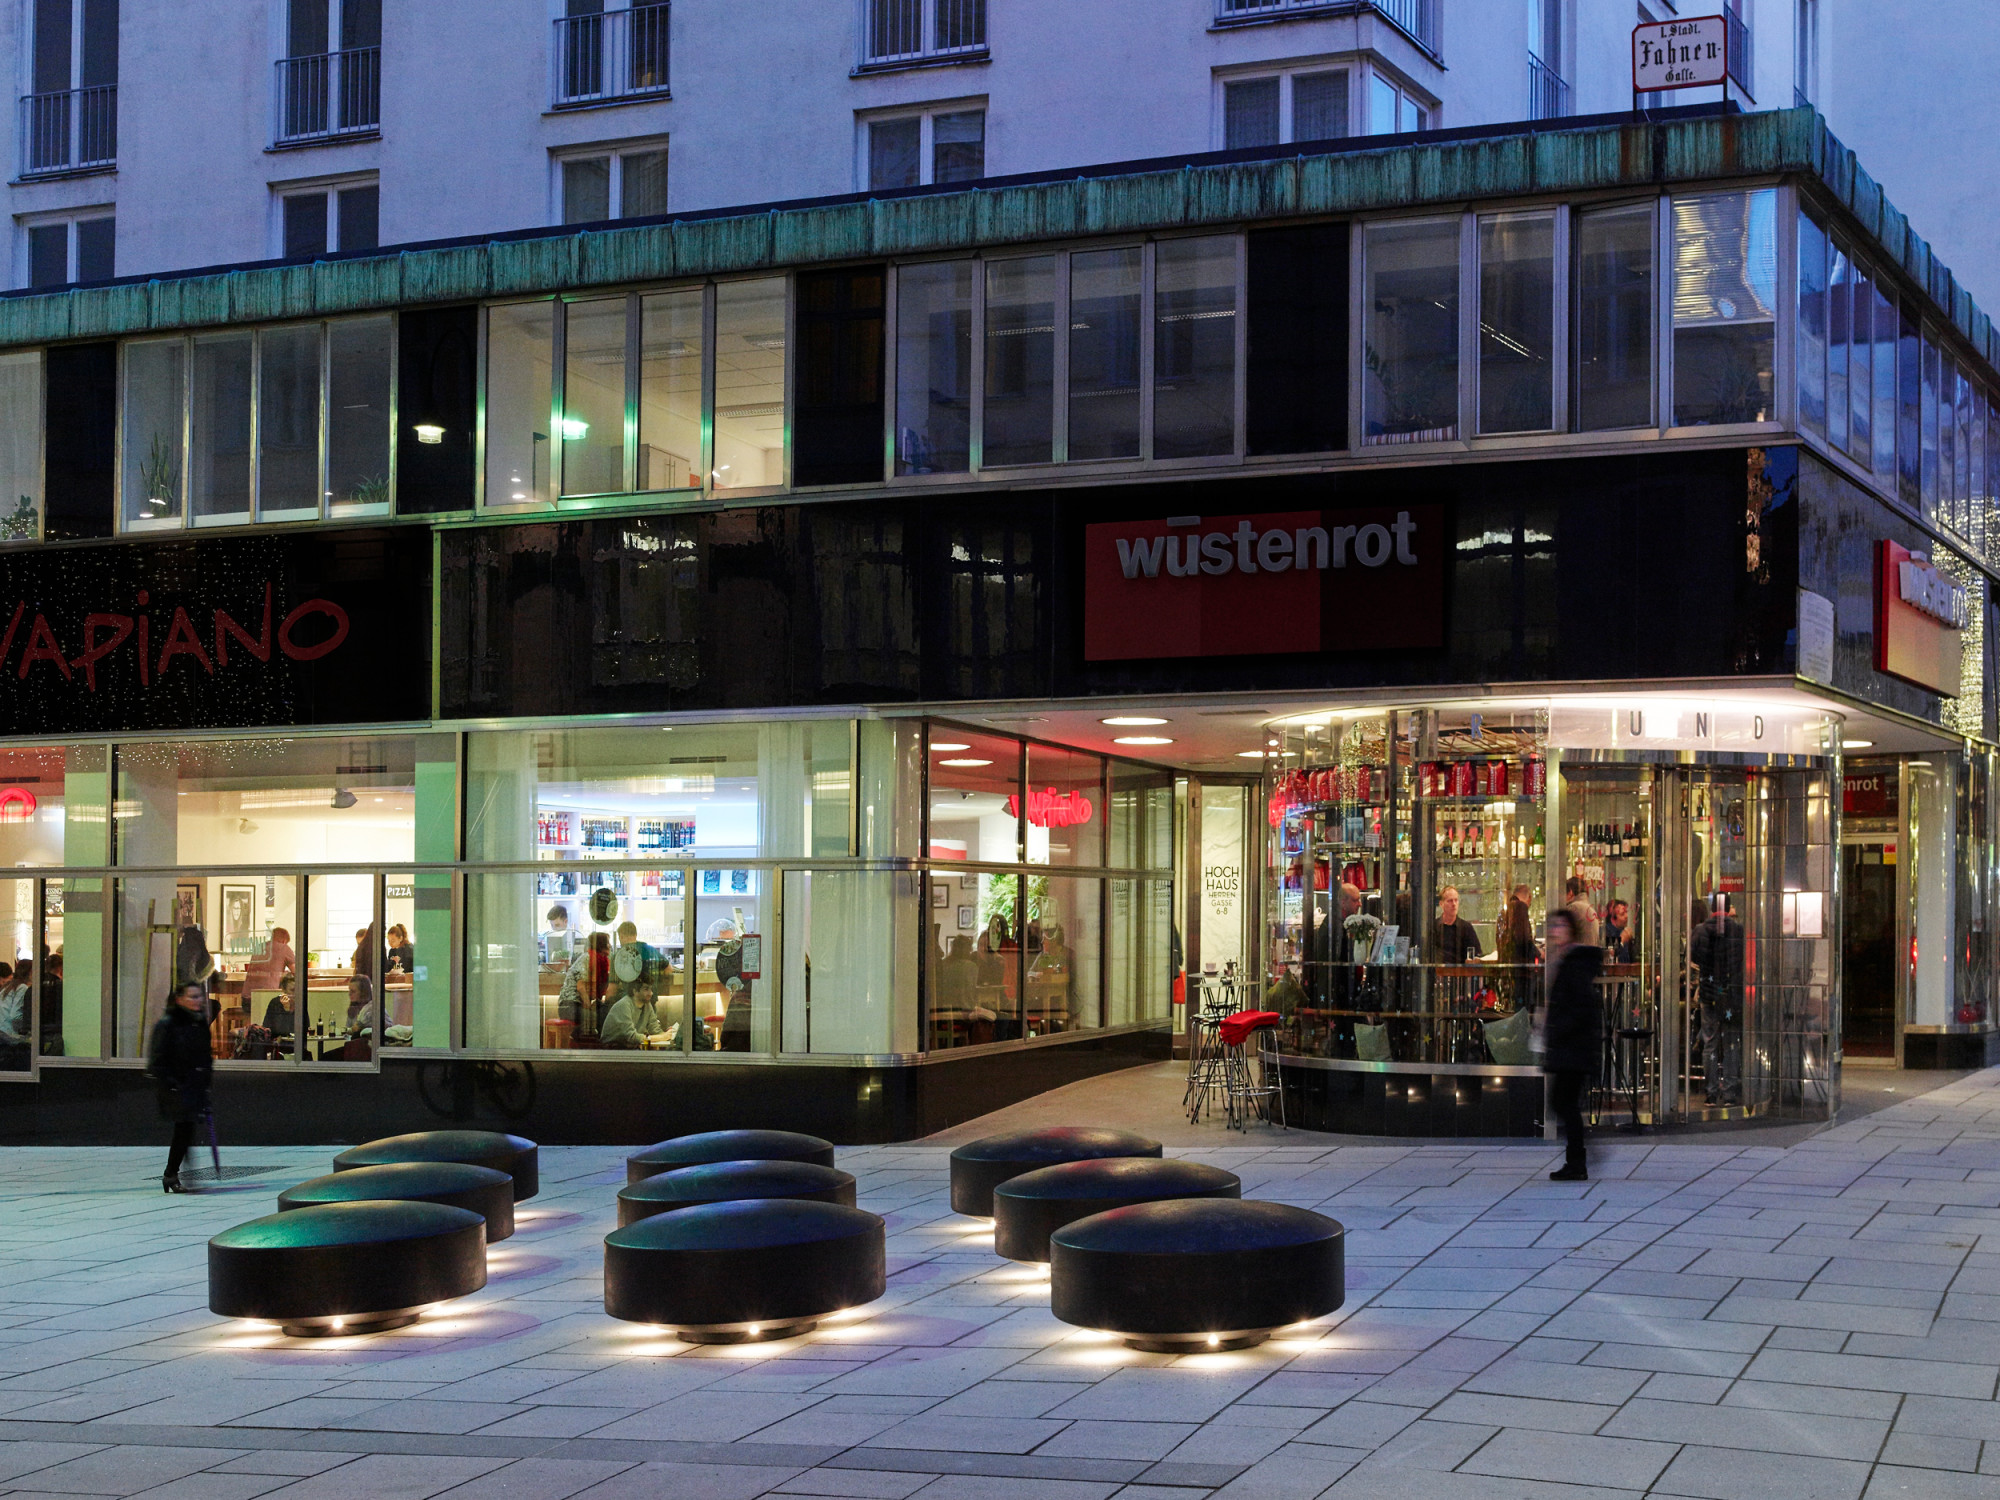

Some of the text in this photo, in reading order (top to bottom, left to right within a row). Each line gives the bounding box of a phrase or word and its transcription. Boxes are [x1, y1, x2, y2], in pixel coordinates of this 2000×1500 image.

[1640, 39, 1721, 69] Fahnen-
[1205, 866, 1239, 878] HOCH
[1206, 878, 1238, 890] HAUS
[387, 886, 412, 897] PIZZA
[1211, 899, 1233, 907] GASSE
[1216, 907, 1228, 915] 6-8
